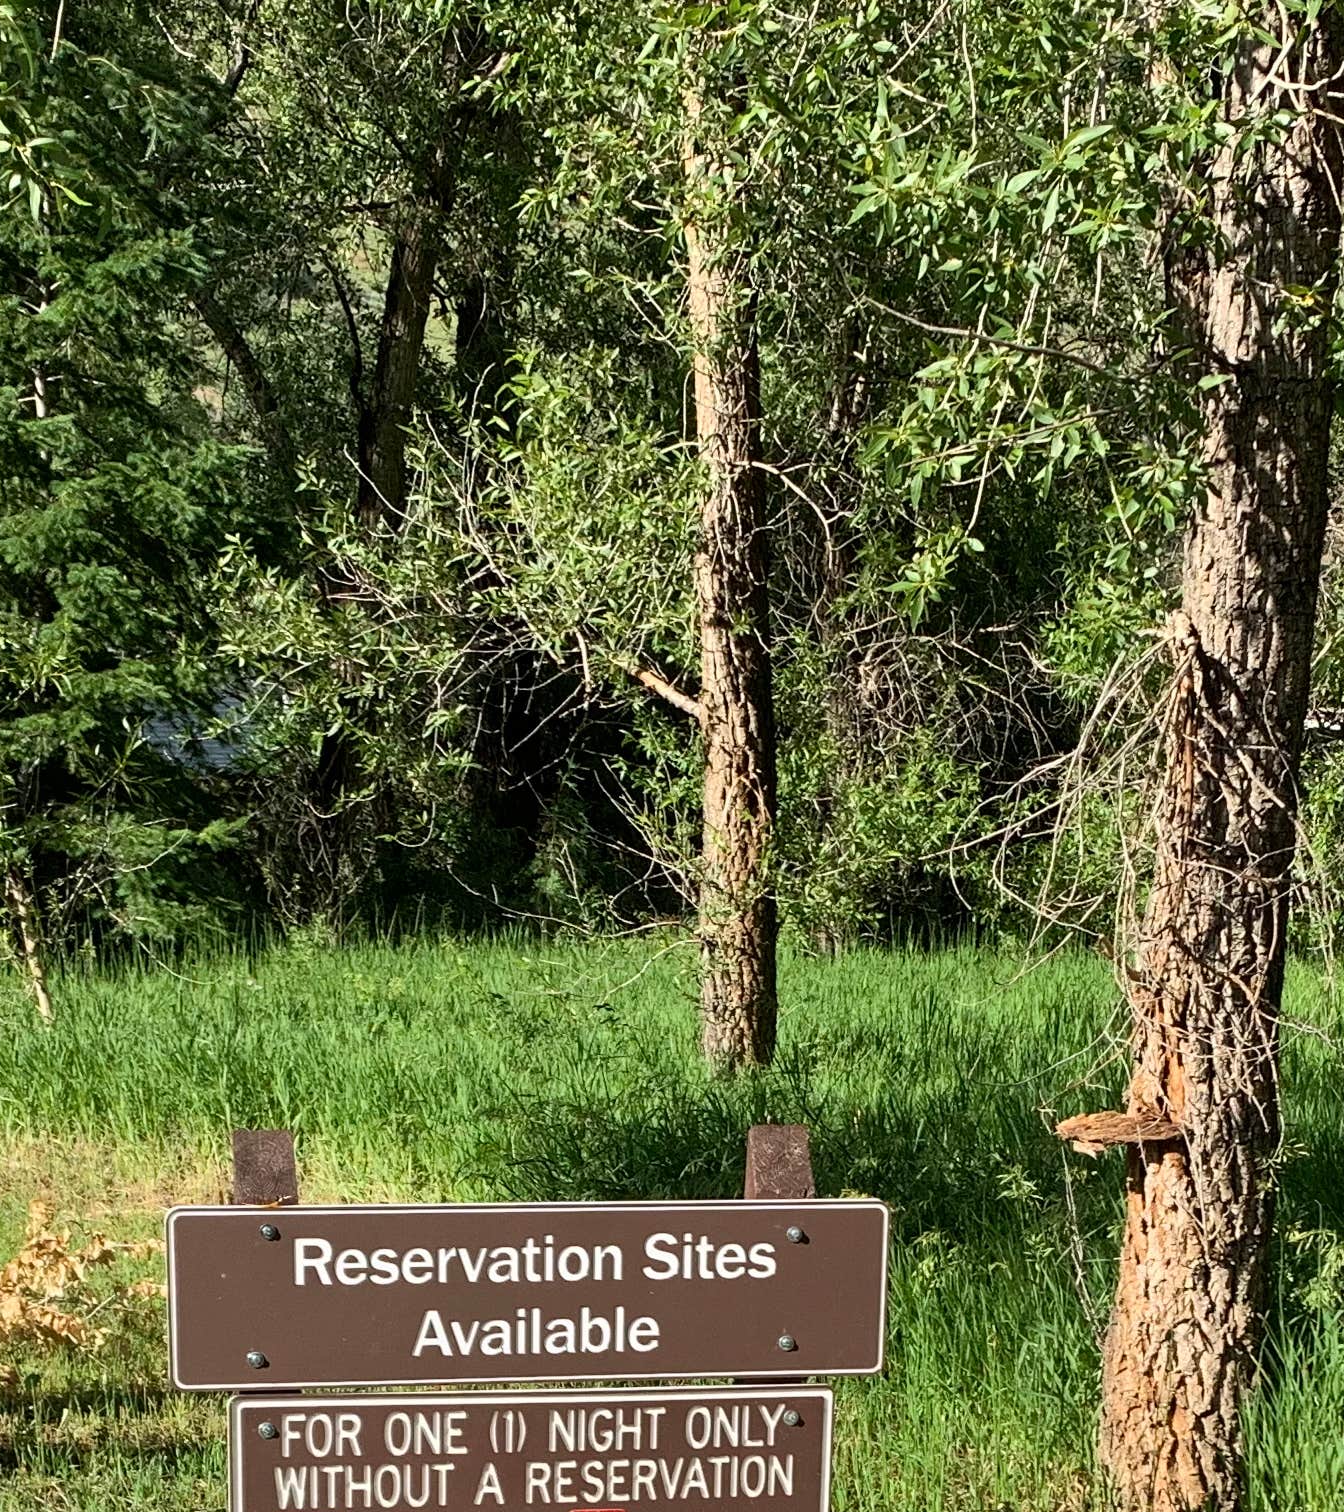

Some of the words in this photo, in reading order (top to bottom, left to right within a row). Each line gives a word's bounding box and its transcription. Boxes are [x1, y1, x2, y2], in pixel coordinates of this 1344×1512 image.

[293, 1234, 624, 1286] Reservation
[642, 1232, 777, 1280] Sites
[411, 1306, 661, 1357] Available
[281, 1412, 363, 1458] FOR
[384, 1411, 468, 1457] ONE
[489, 1410, 527, 1454] (1)
[548, 1406, 666, 1452] NIGHT
[685, 1403, 786, 1449] ONLY
[273, 1463, 455, 1510] WITHOUT
[473, 1462, 505, 1506] A
[525, 1454, 794, 1504] RESERVATION
